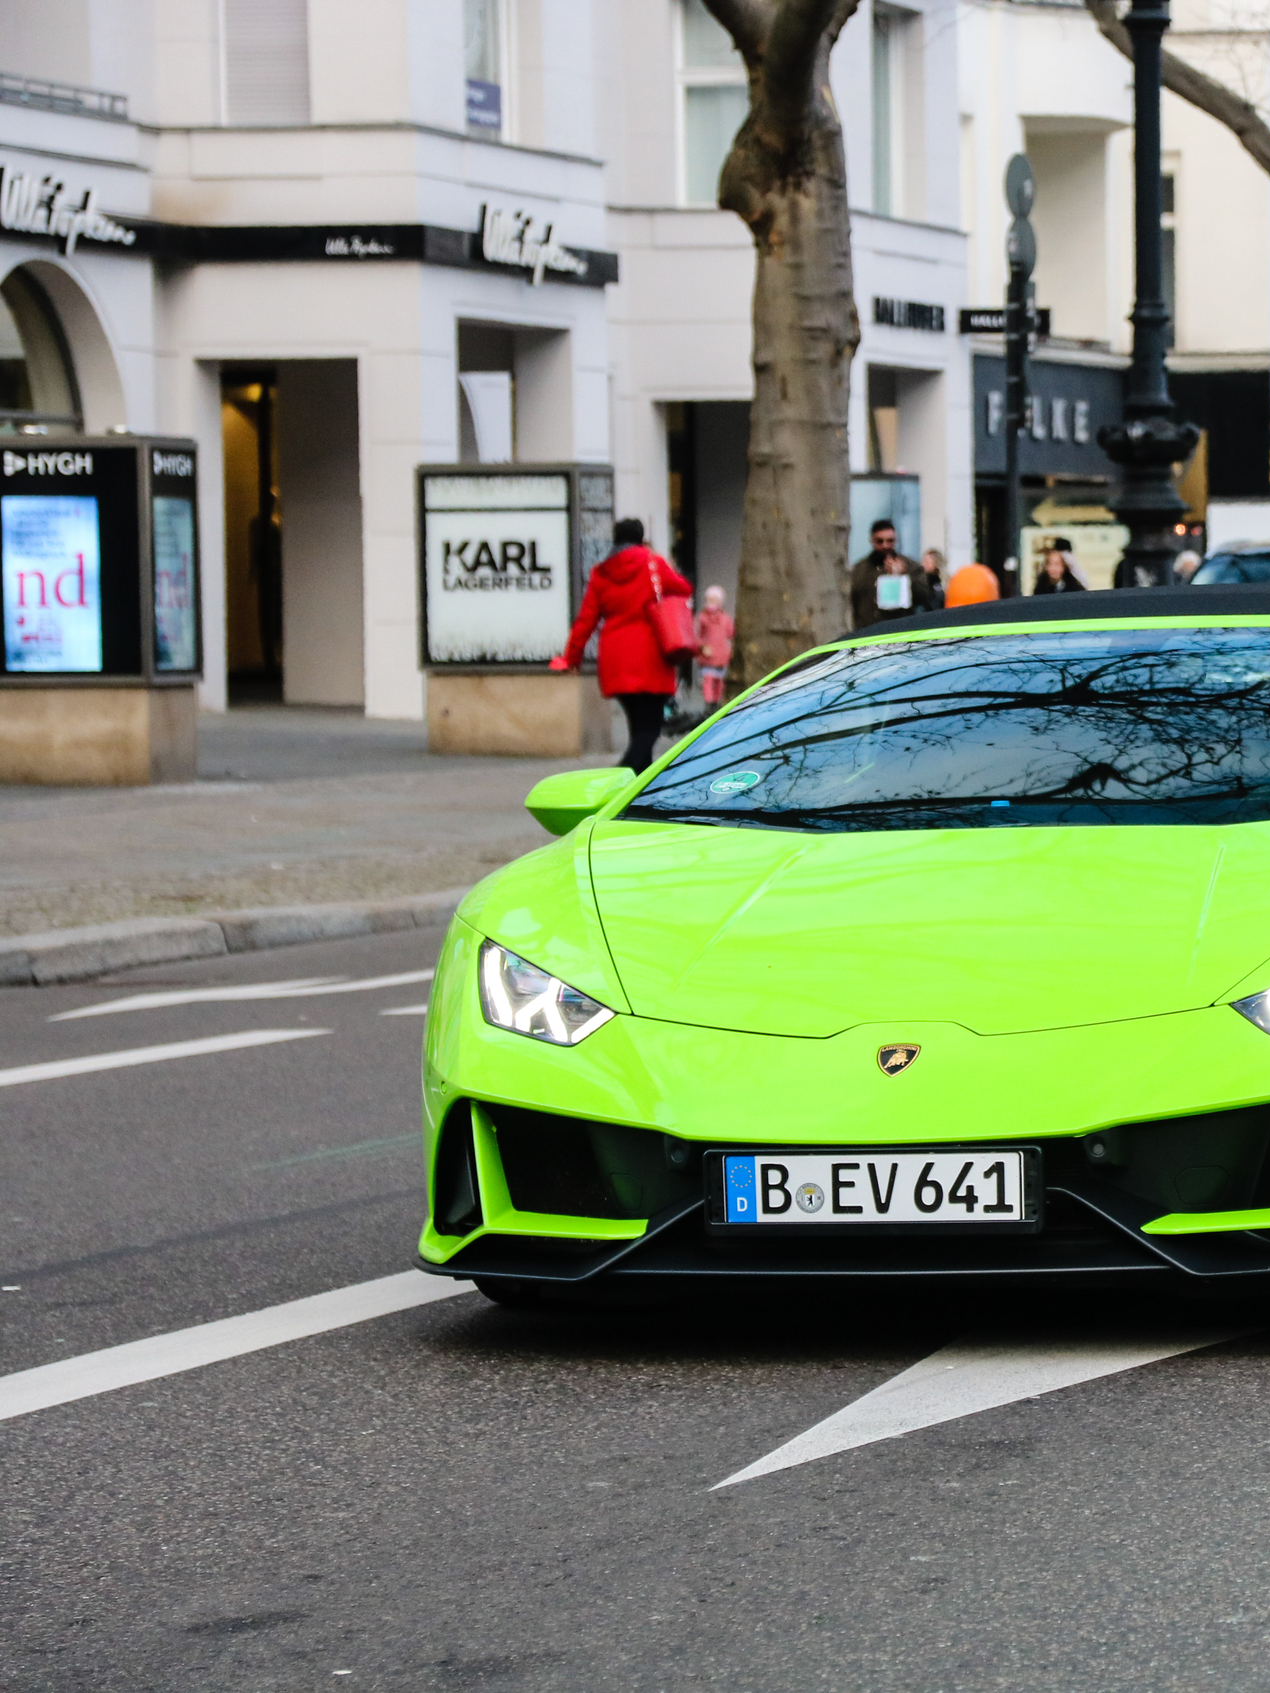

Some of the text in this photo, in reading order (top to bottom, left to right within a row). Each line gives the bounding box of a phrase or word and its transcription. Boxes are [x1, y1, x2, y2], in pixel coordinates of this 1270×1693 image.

[987, 391, 1089, 443] FLKE
[27, 452, 93, 475] HYGH
[443, 540, 551, 573] KARL
[16, 551, 88, 609] nd
[443, 574, 552, 591] LAGERFELD
[760, 1161, 1014, 1214] B EV 641
[736, 1197, 748, 1212] D
